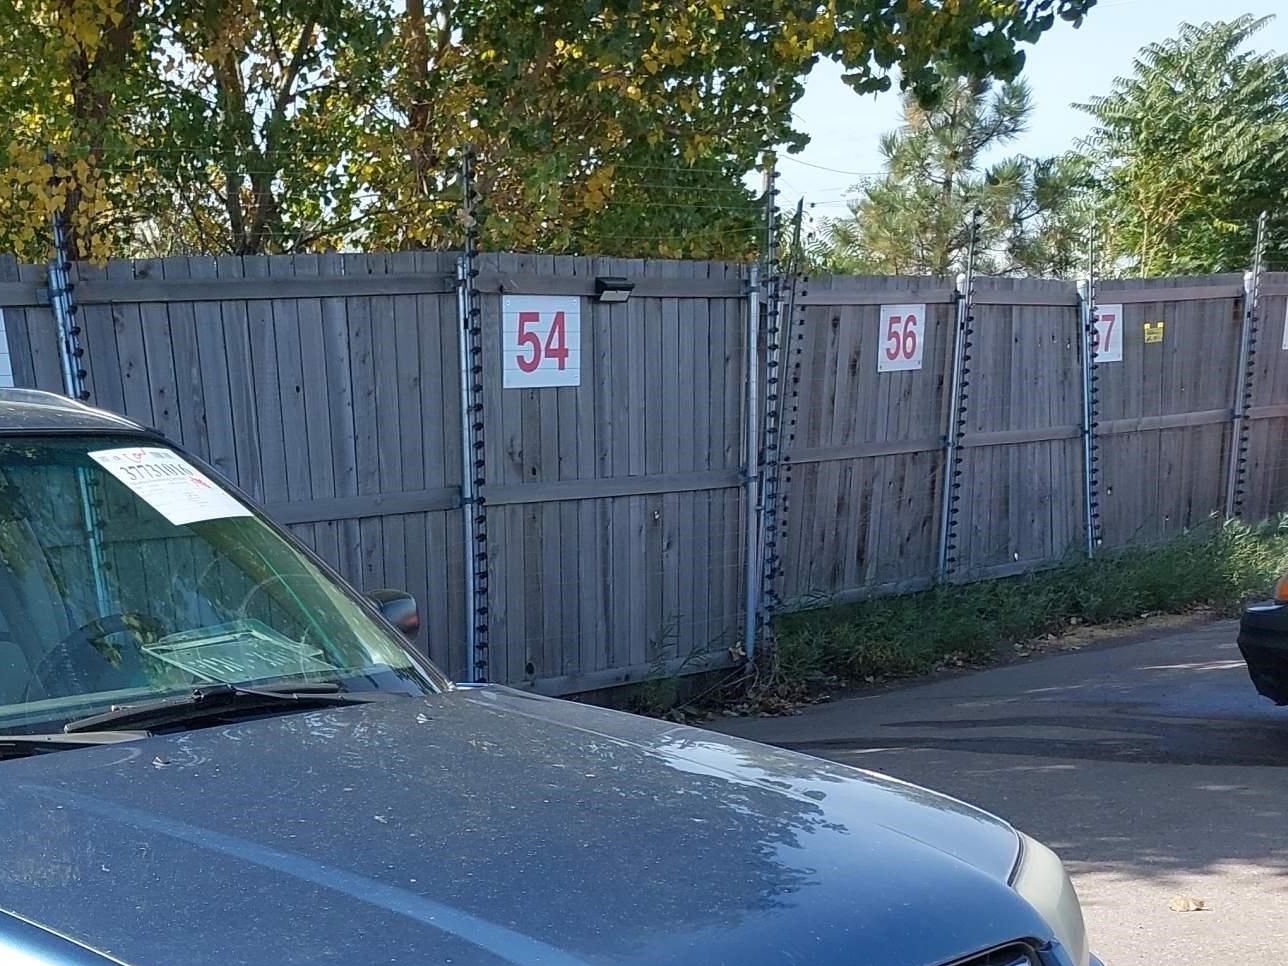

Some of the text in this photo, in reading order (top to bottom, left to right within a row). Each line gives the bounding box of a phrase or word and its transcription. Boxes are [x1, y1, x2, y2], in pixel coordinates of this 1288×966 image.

[515, 310, 569, 373] 54
[885, 314, 918, 361] 56
[119, 462, 194, 482] 37731016
